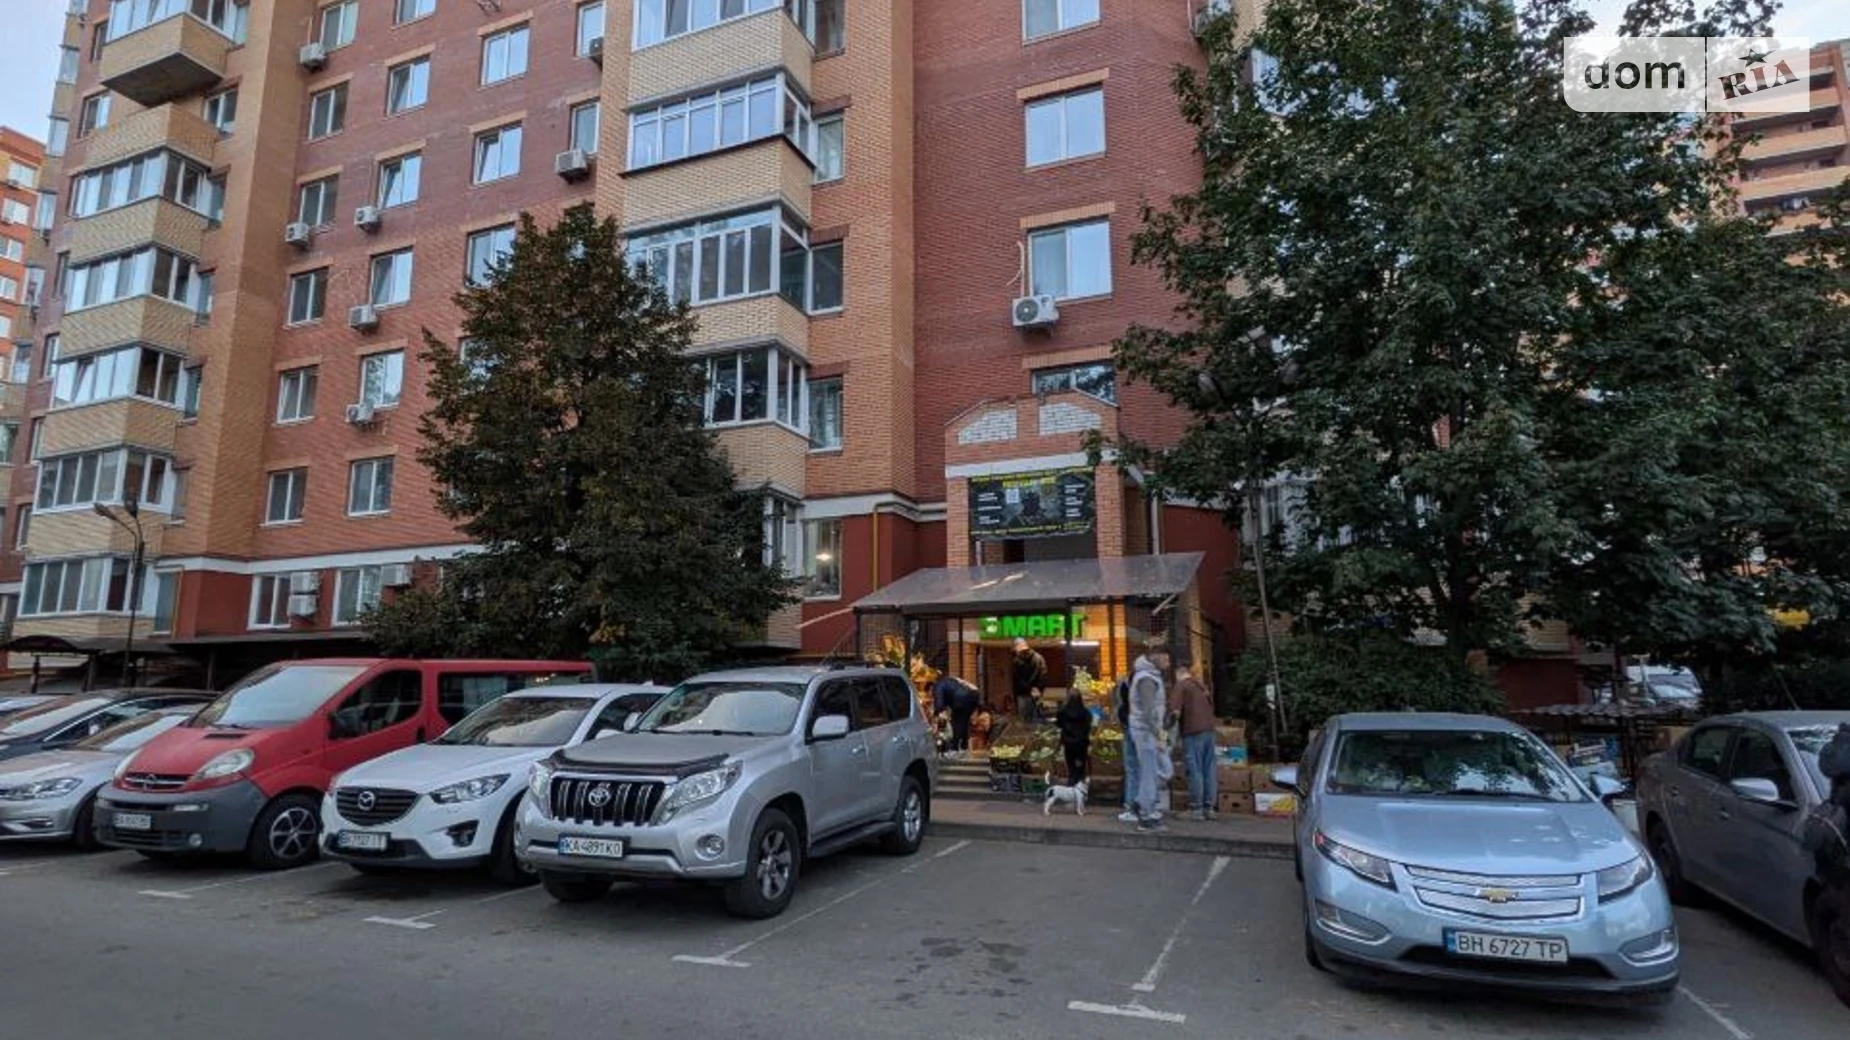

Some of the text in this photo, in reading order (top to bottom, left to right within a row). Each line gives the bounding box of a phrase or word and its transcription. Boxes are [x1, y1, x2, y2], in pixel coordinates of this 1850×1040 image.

[1458, 935, 1563, 959] BH 6727 TP
